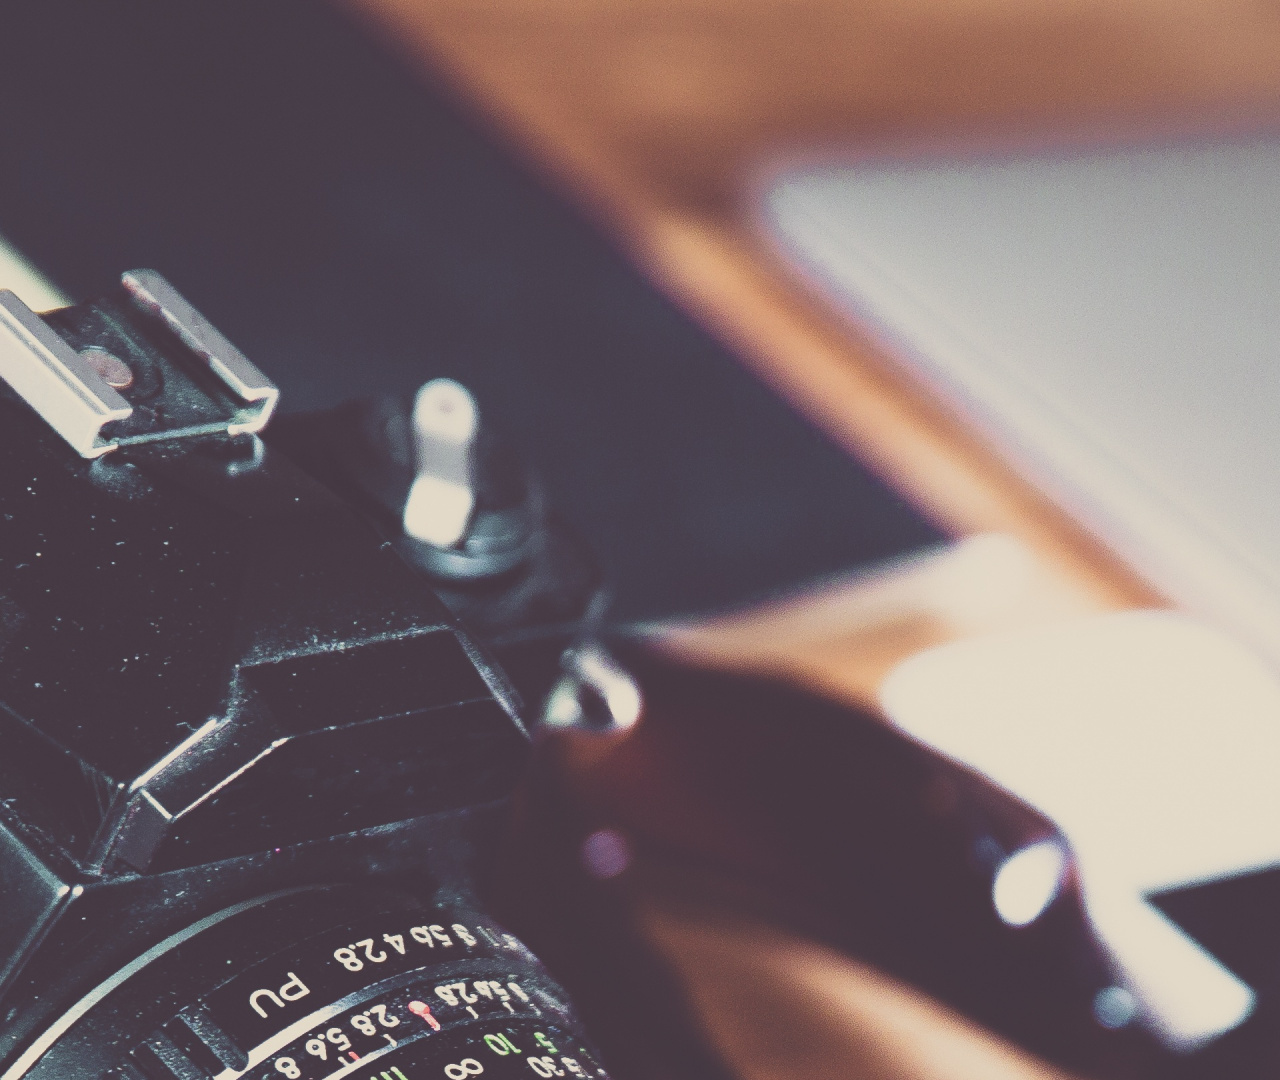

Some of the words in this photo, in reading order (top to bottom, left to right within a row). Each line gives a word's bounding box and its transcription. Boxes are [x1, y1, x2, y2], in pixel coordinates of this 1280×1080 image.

[333, 938, 388, 971] 2.8
[383, 933, 406, 954] 4
[249, 972, 310, 1018] PU
[350, 1004, 400, 1036] 2.8
[305, 1027, 352, 1061] 5.6
[483, 1033, 522, 1056] 10
[274, 1057, 301, 1080] 8
[526, 1056, 566, 1078] 30
